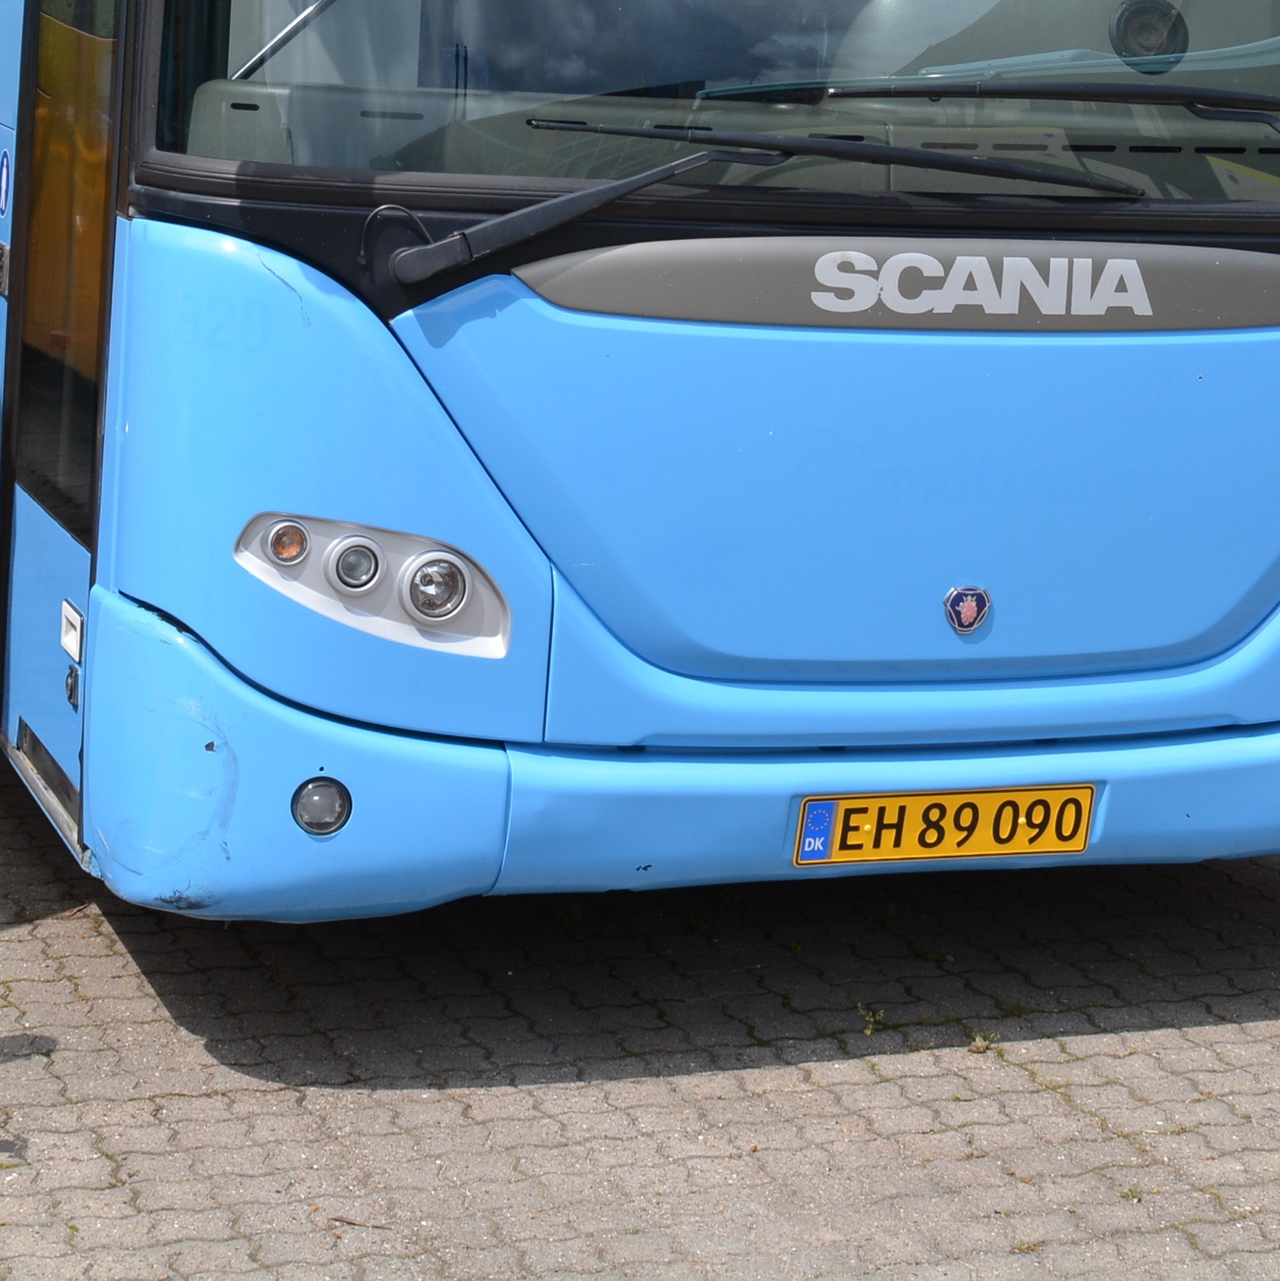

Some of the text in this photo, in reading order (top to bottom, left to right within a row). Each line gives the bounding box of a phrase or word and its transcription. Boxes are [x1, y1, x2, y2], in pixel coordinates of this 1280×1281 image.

[810, 250, 1154, 316] SCANIA
[804, 836, 824, 852] DK
[838, 797, 1083, 851] EH 89 090
